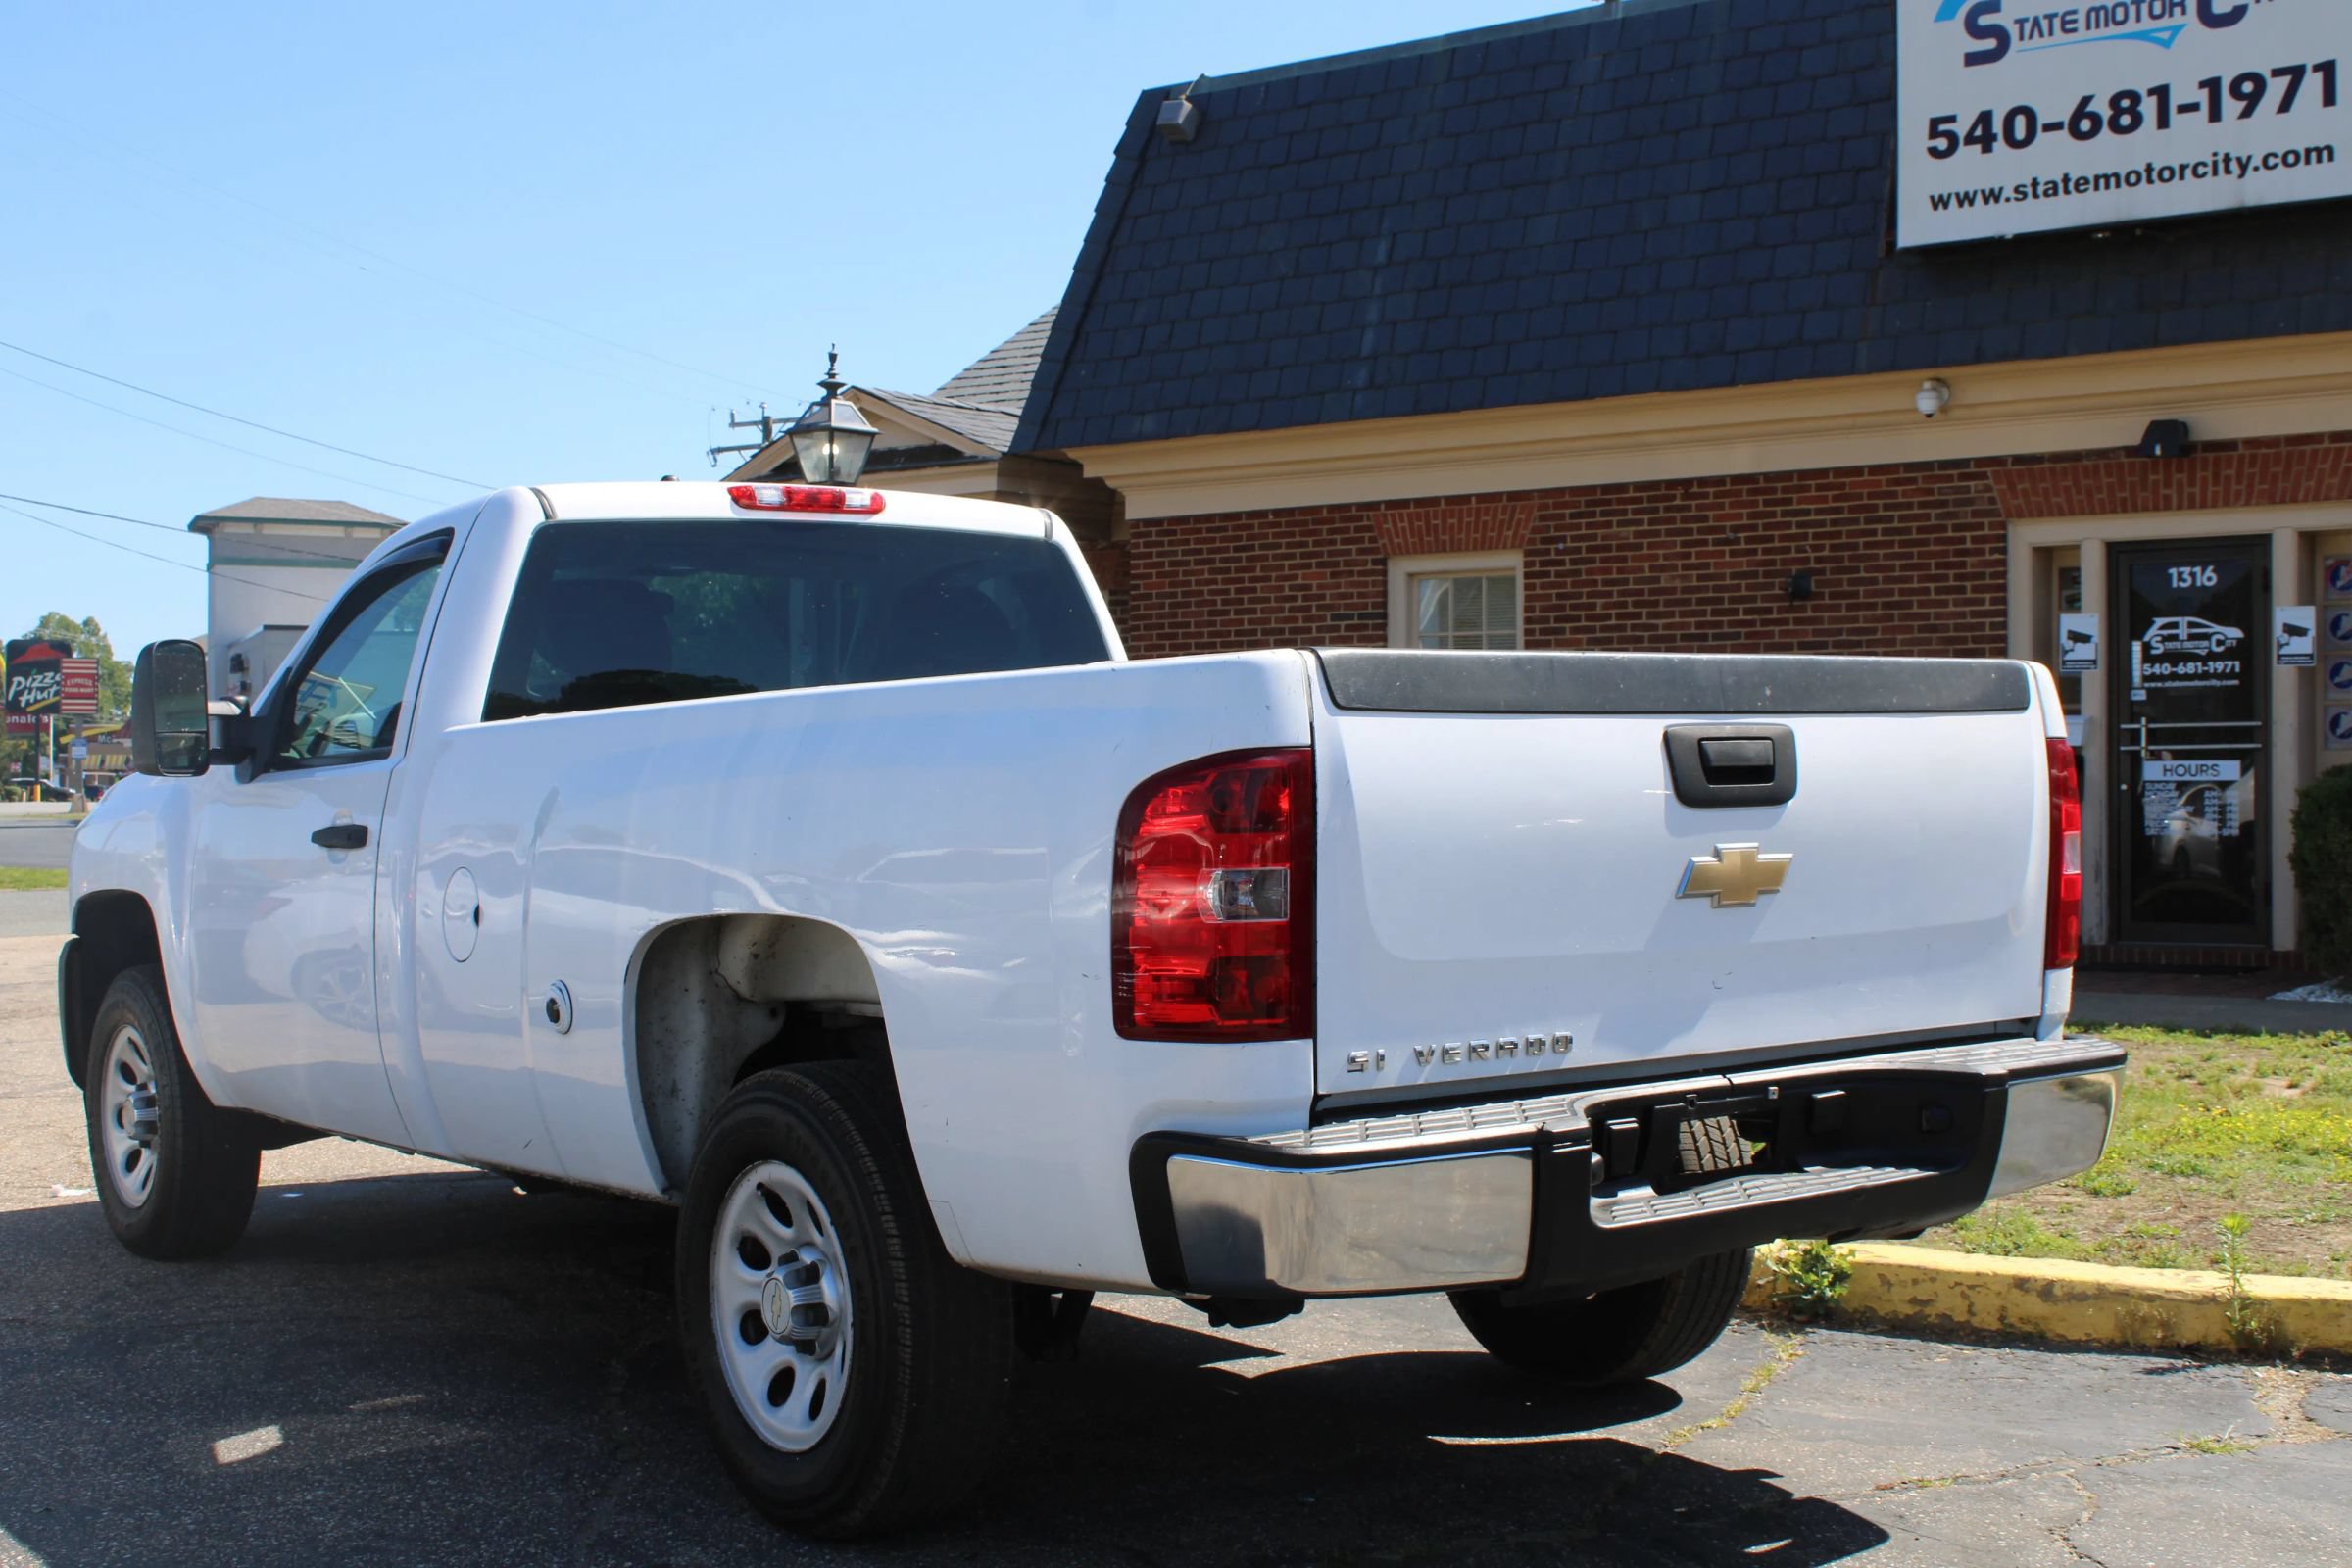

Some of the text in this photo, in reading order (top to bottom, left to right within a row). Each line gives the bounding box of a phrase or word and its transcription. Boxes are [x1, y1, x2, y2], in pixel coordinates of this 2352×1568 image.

[1963, 0, 2078, 67] STATE
[2085, 0, 2187, 31] MOTOR
[1927, 59, 2337, 159] 540-681-1971
[1930, 143, 2335, 211] www.statemotorcity.com
[2168, 565, 2217, 588] 1316
[2143, 661, 2240, 675] 540-681-1971
[19, 685, 60, 708] Hut
[2163, 763, 2220, 777] HOURS
